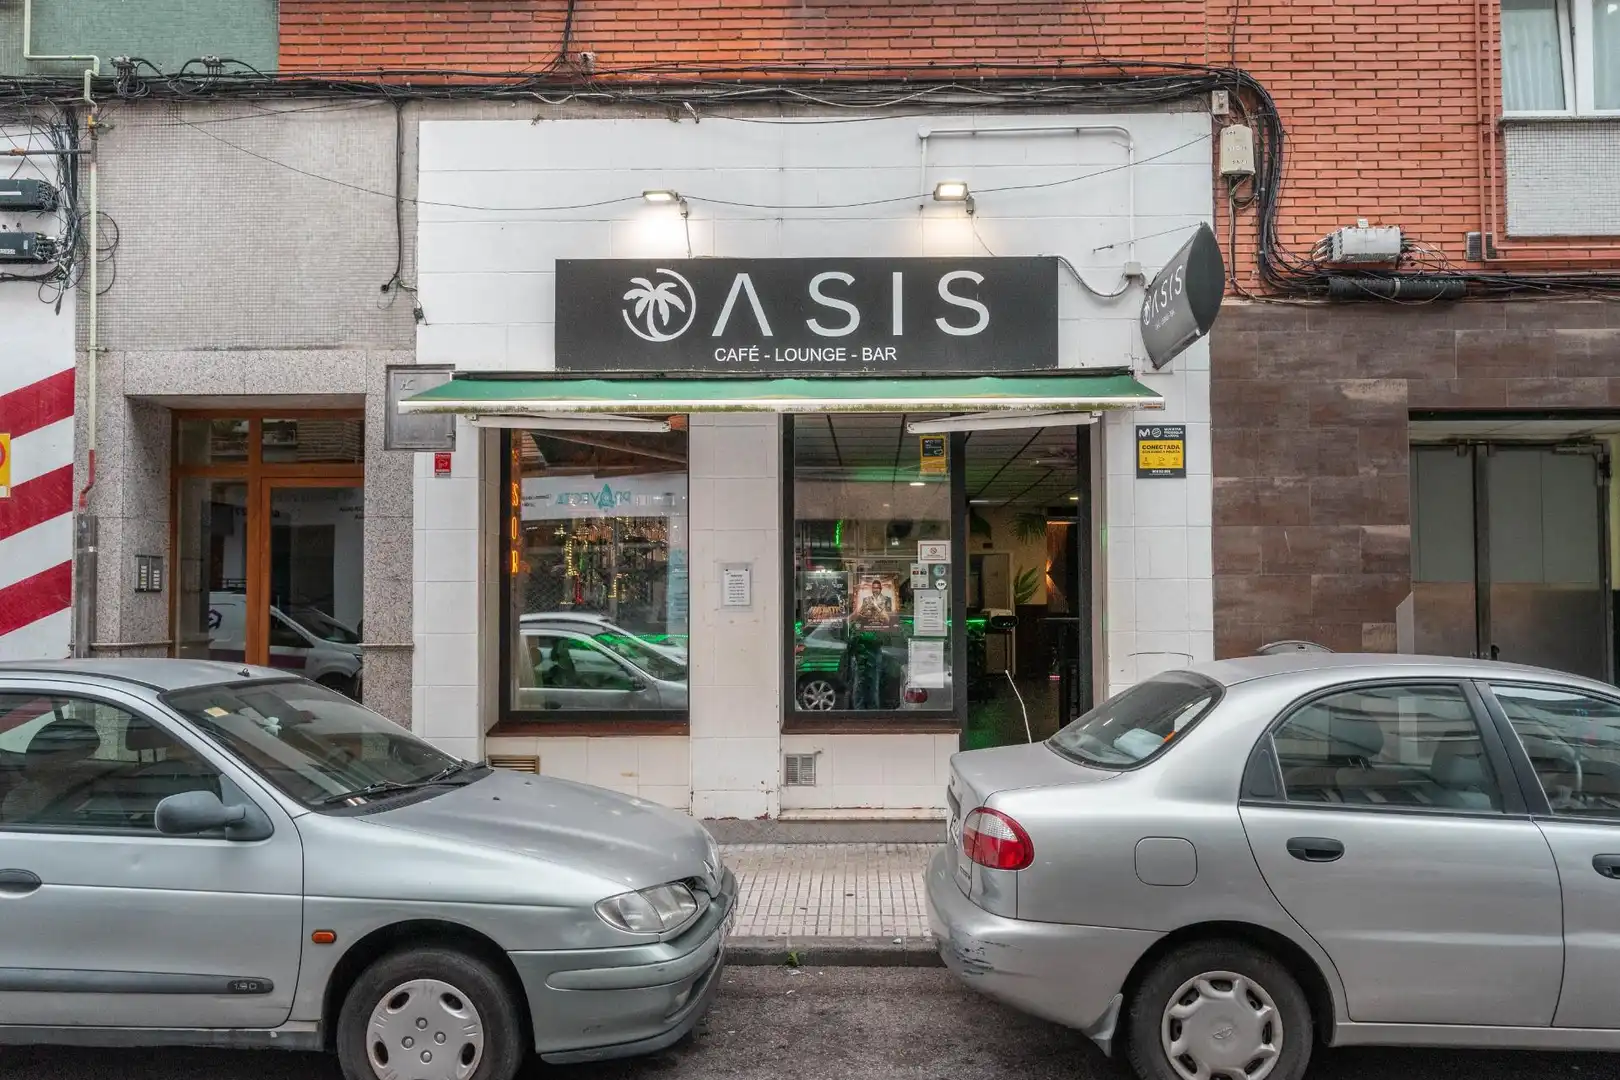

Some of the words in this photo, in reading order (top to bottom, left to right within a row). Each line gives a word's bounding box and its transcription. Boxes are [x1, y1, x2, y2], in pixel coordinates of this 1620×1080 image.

[714, 345, 760, 362] CAFÉ
[775, 347, 847, 362] LOUNGE
[862, 347, 897, 361] BAR
